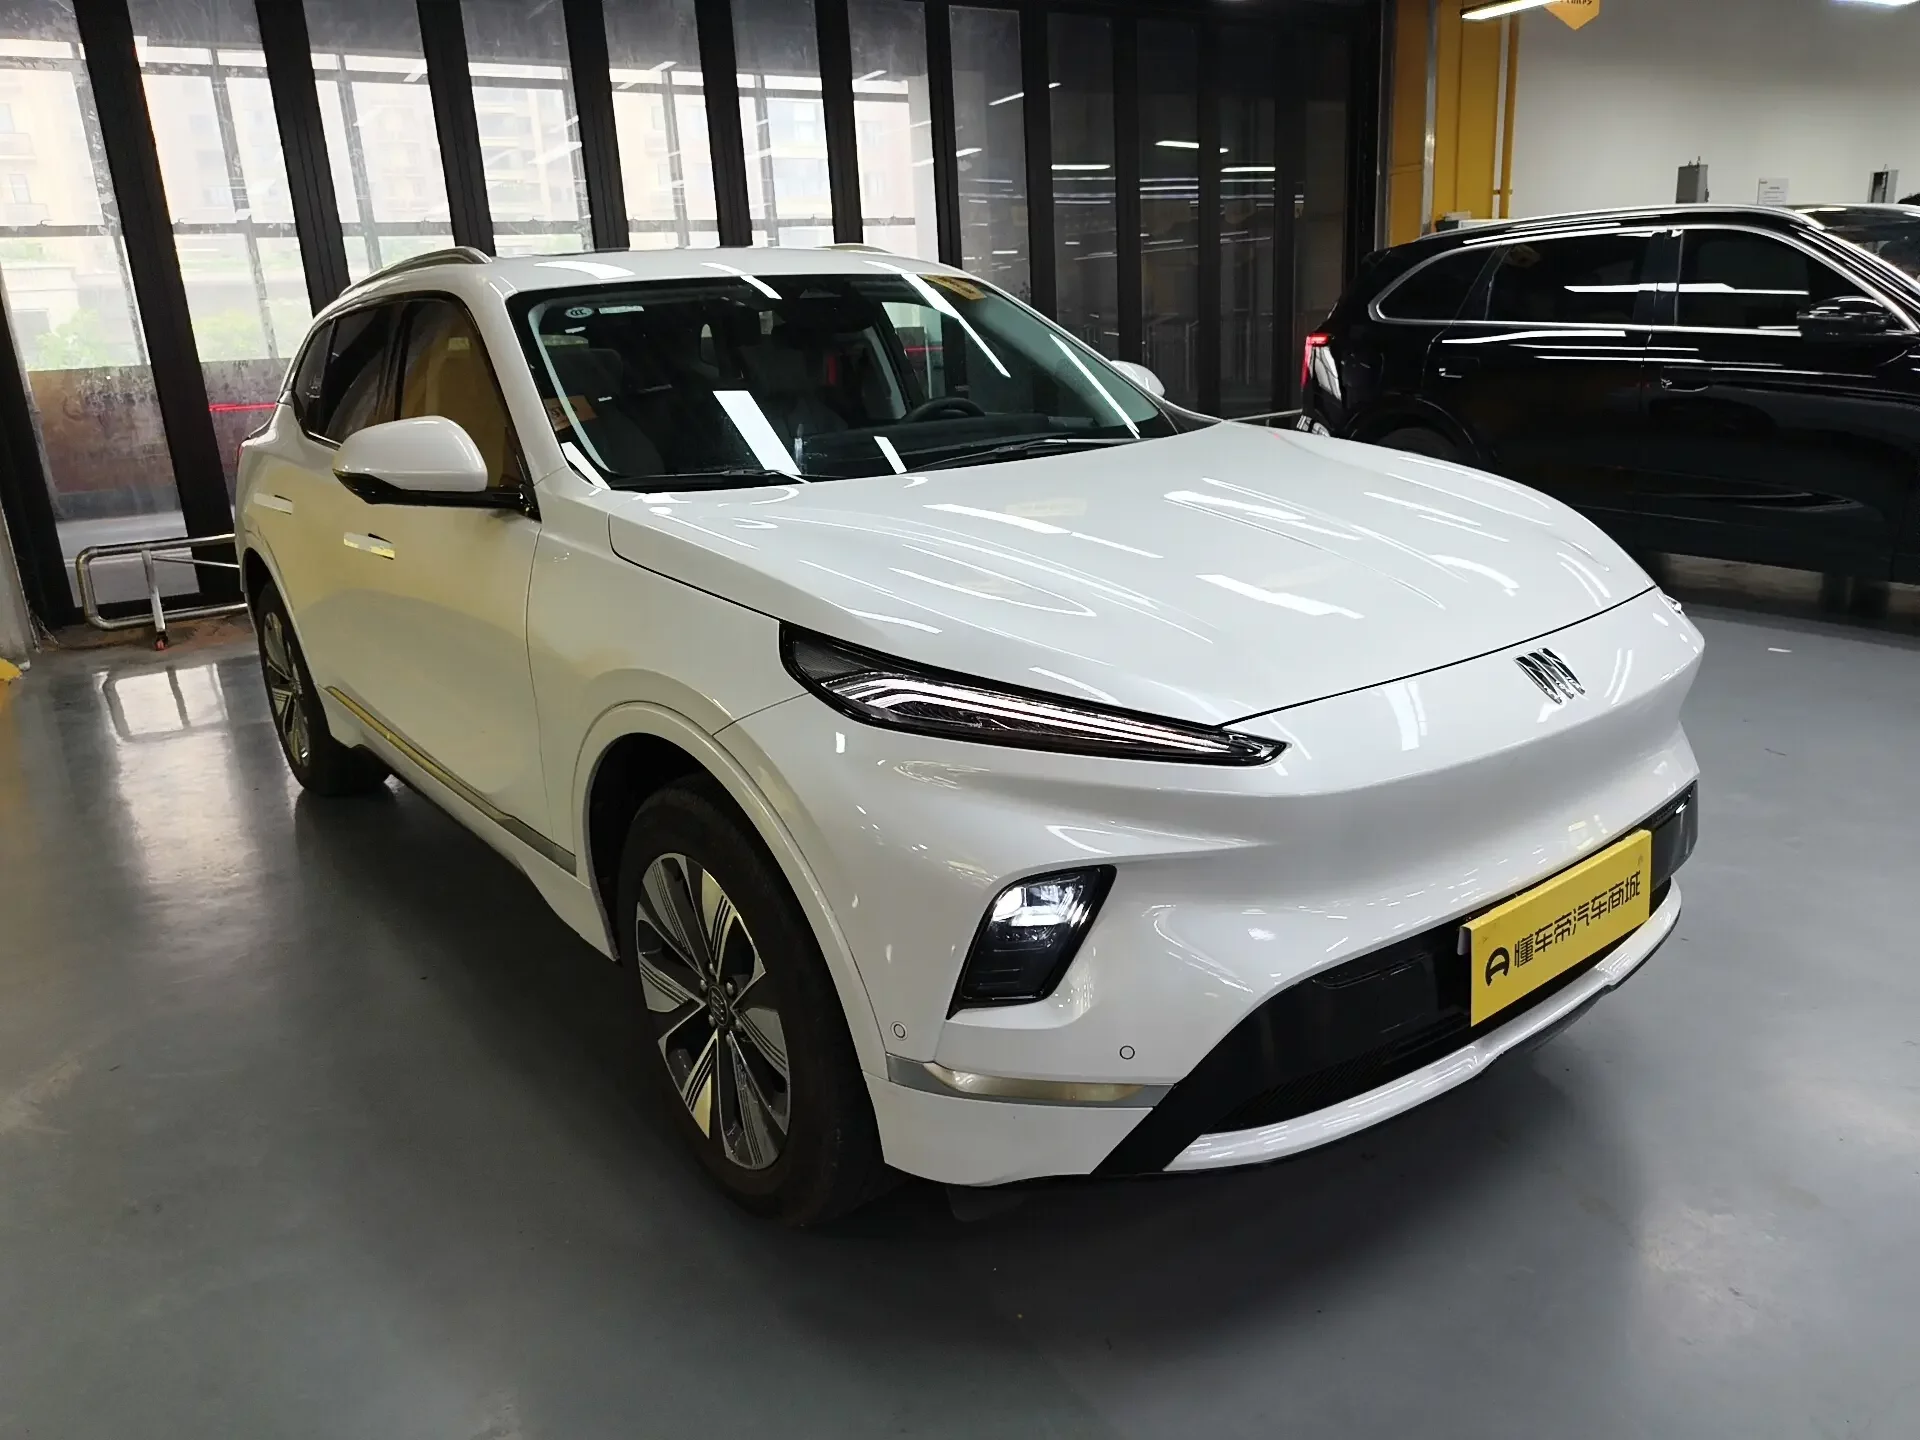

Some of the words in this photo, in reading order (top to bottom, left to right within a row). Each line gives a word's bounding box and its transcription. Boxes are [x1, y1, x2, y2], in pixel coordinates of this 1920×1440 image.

[1514, 870, 1641, 968] 懂车帝汽车商城
